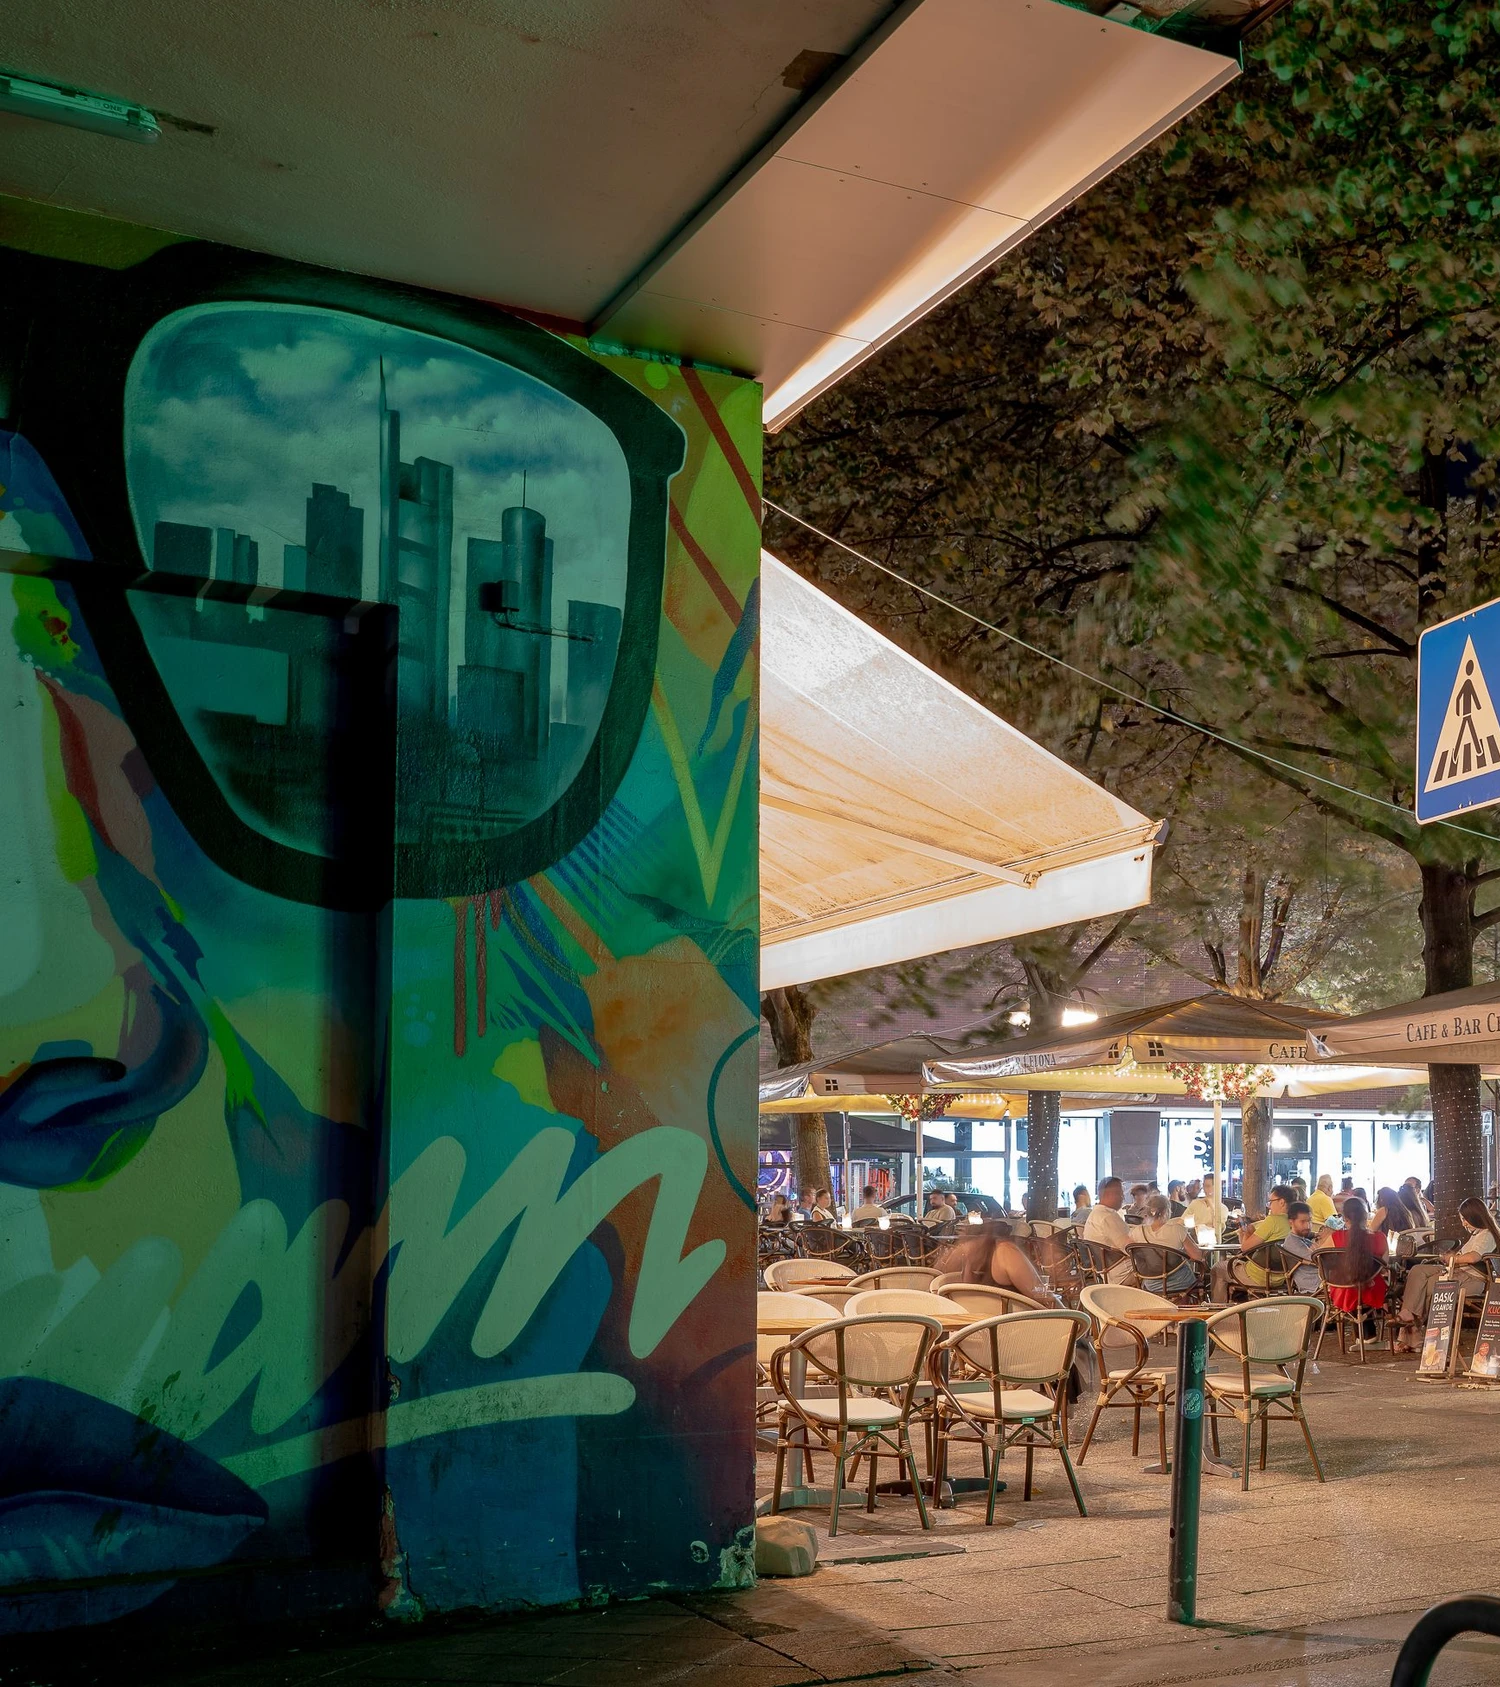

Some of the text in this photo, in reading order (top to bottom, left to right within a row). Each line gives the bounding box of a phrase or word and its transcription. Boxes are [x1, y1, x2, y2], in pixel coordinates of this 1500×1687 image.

[1406, 1023, 1437, 1042] CAFE
[1441, 1023, 1449, 1038] &
[1454, 1017, 1481, 1037] BAR
[1433, 1291, 1455, 1303] BASIC
[1432, 1303, 1453, 1312] GRANDE
